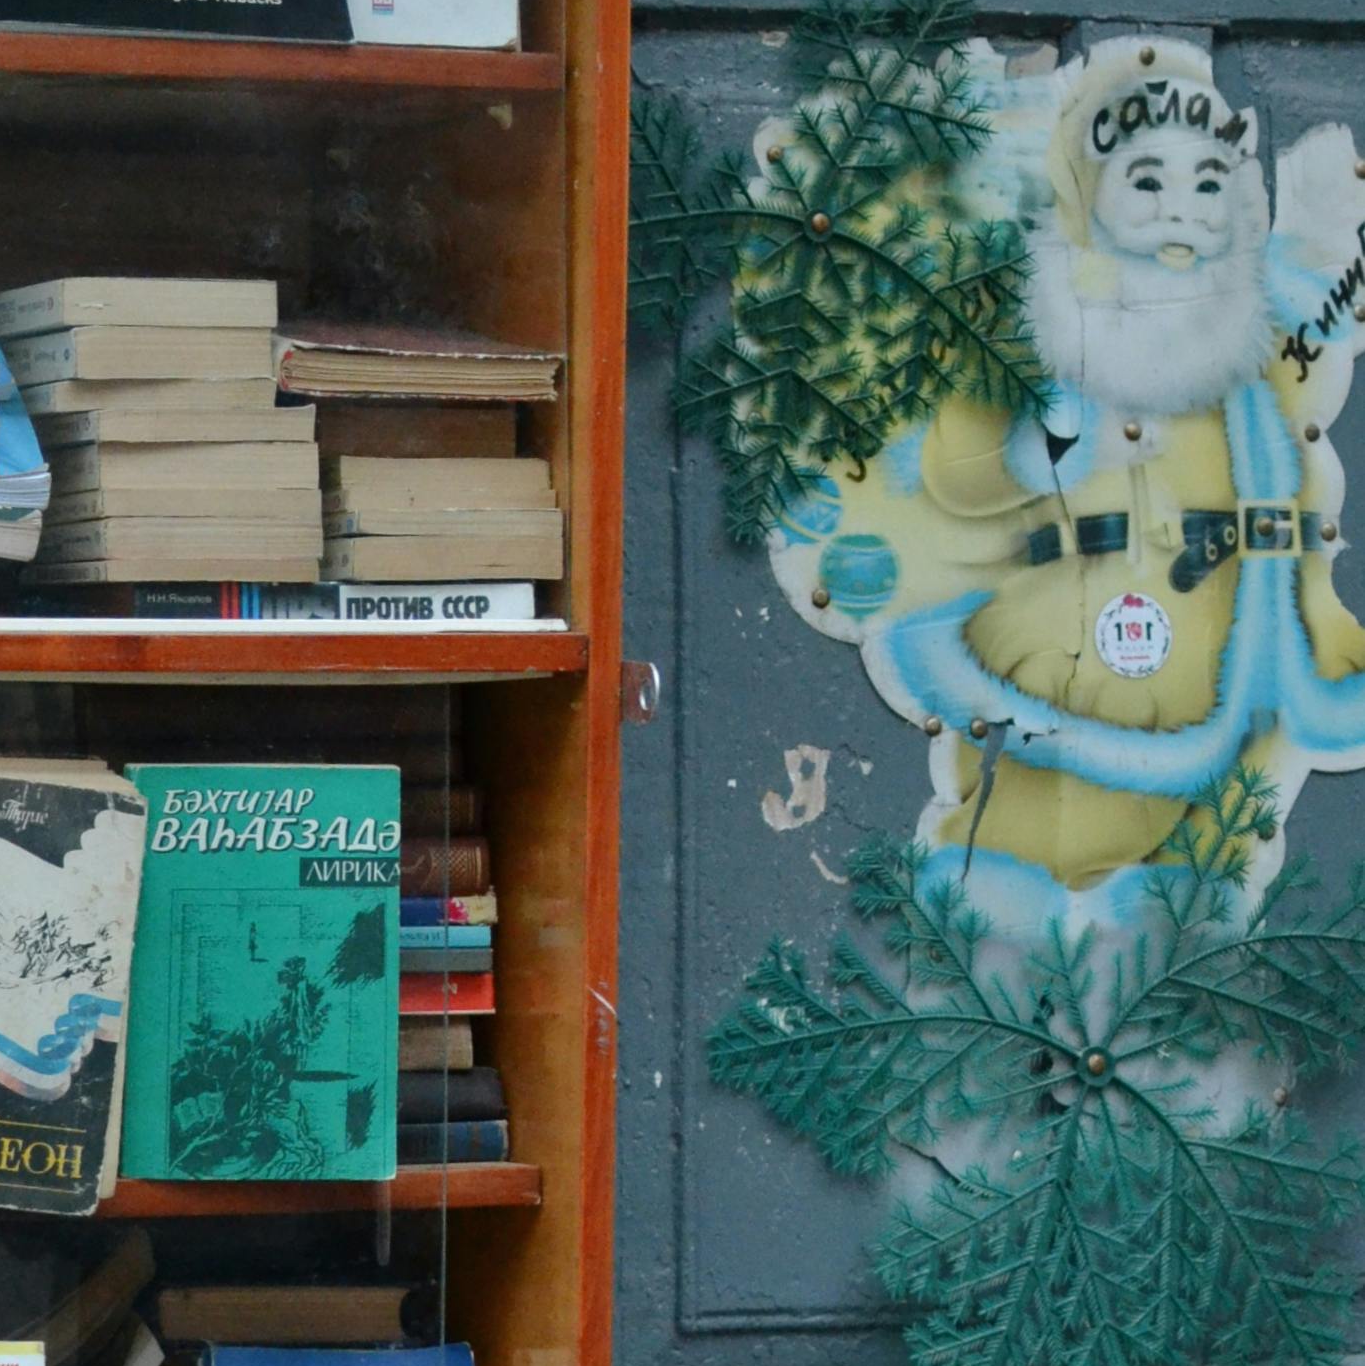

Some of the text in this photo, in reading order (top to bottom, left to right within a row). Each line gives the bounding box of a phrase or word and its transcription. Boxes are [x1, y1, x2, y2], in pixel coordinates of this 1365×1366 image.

[346, 593, 490, 620] ПРОТИВ СССР
[303, 857, 401, 885] ЛИРИКА
